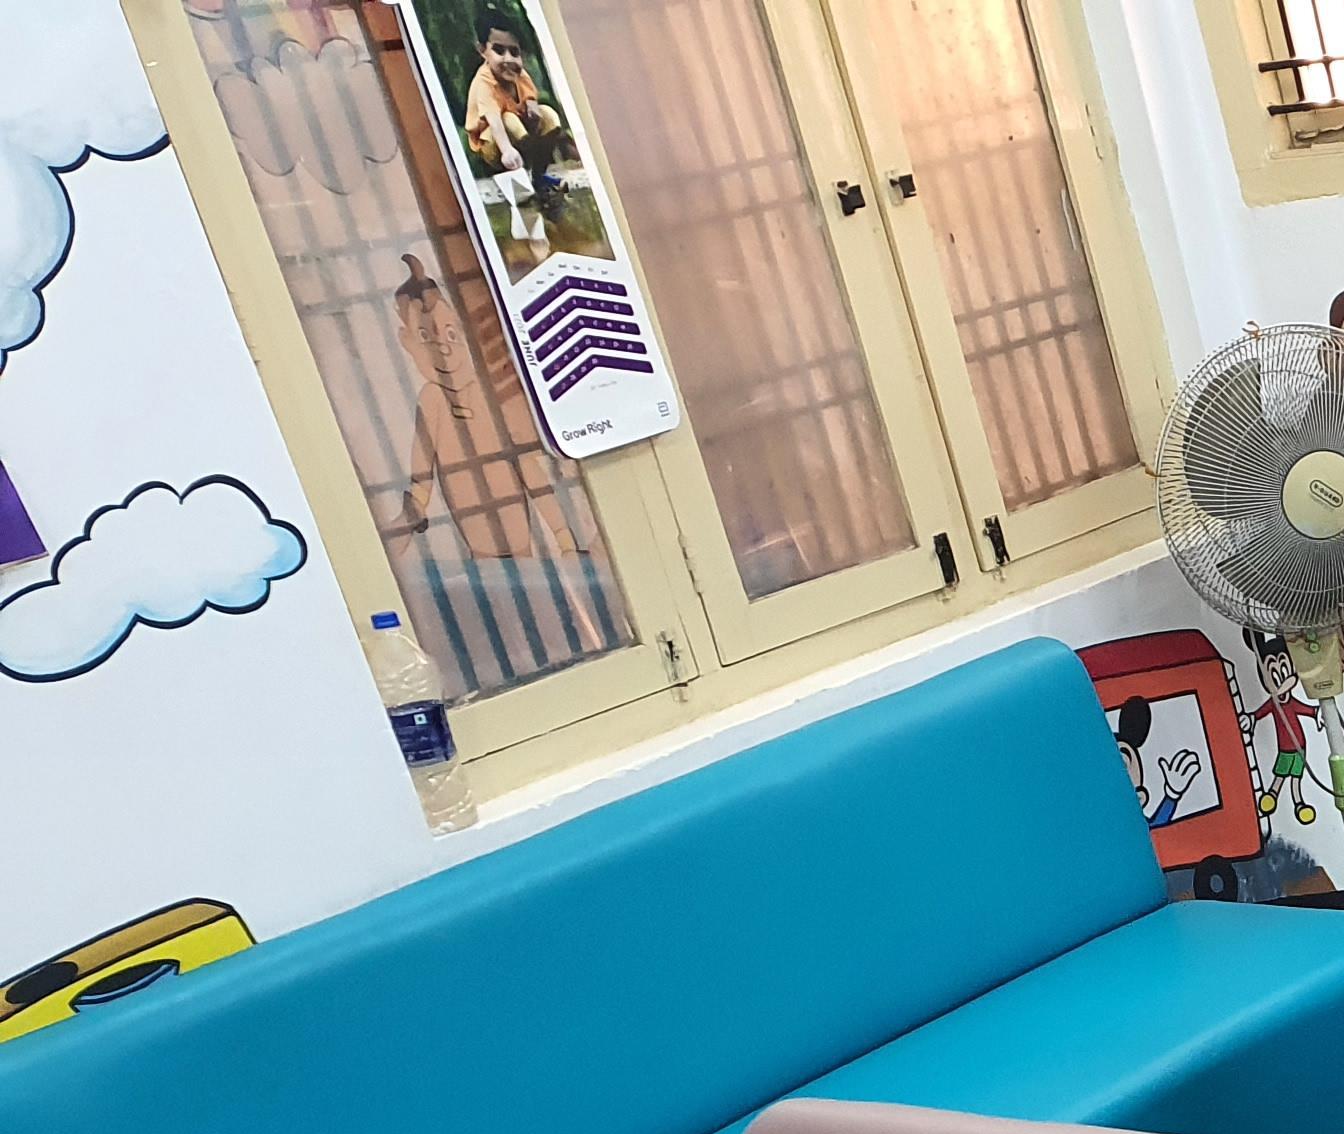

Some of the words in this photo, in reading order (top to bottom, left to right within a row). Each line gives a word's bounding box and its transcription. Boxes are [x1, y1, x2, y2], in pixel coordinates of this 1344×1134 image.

[521, 340, 538, 366] JUNE
[561, 429, 587, 441] Grow
[587, 419, 613, 434] Right
